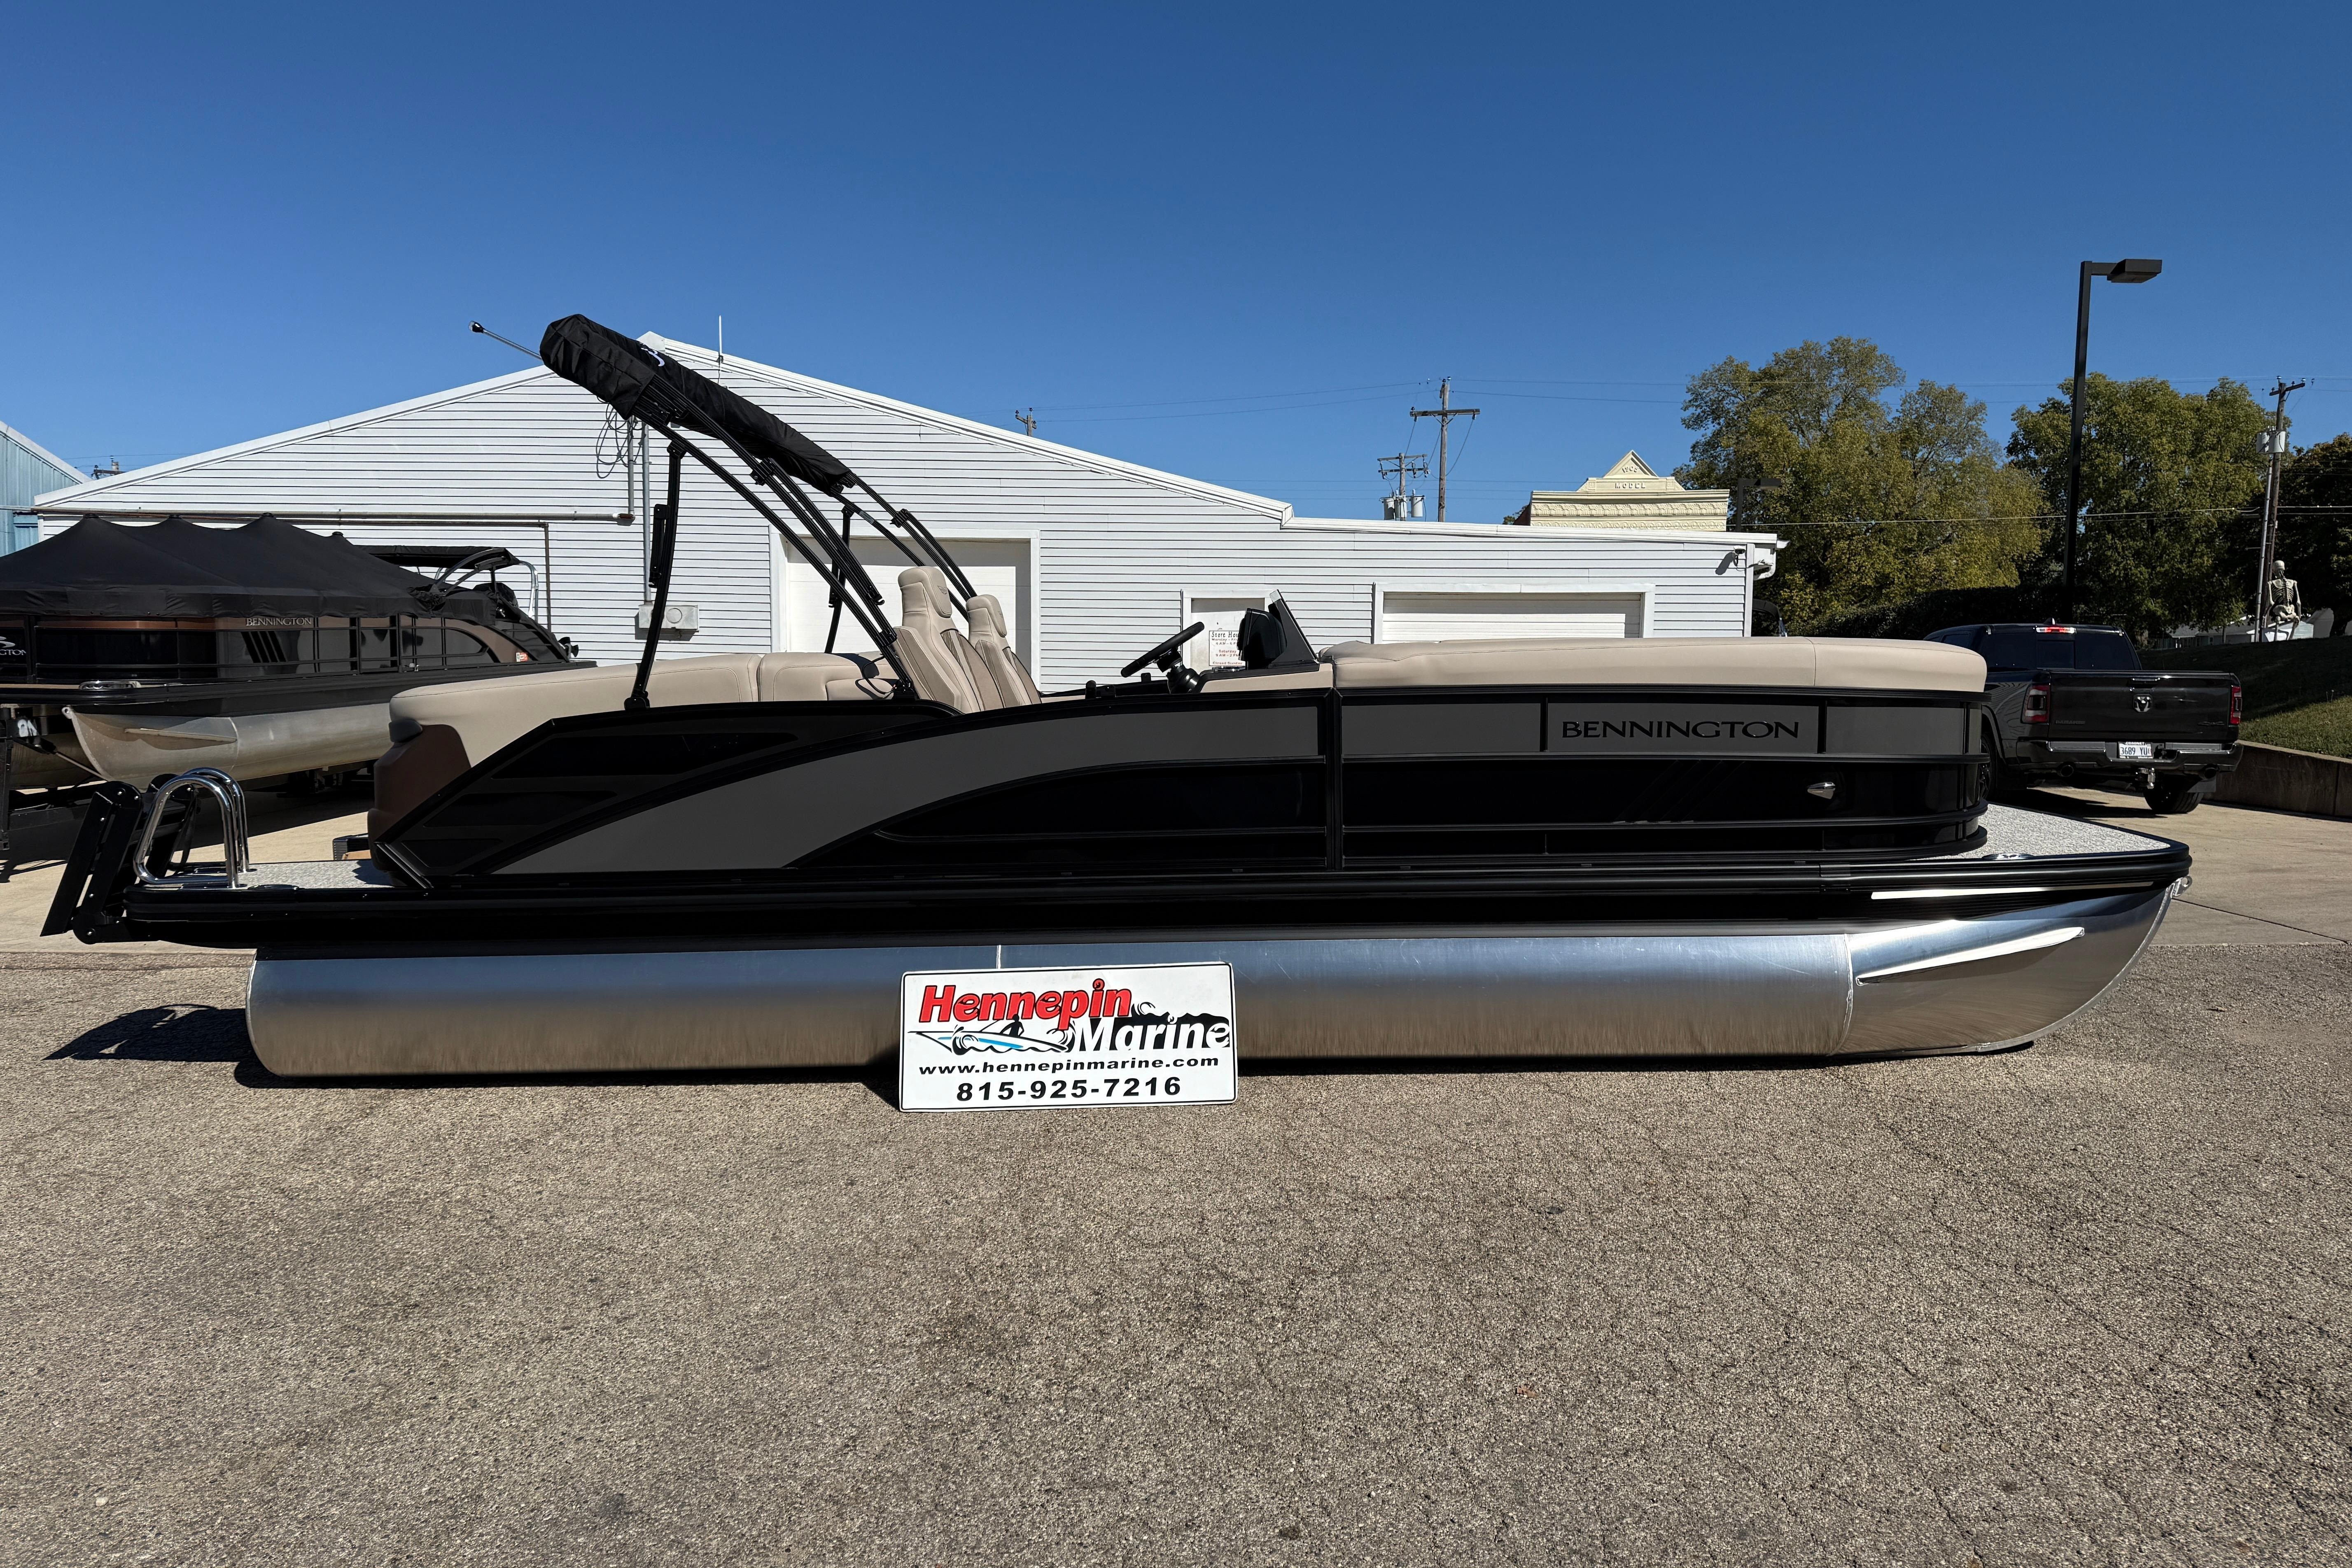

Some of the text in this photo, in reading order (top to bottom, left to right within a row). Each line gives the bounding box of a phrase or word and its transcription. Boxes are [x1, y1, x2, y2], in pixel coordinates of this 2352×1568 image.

[246, 618, 311, 626] BENNINGTON
[1562, 721, 1799, 738] BENNINGTON
[2120, 747, 2135, 755] 3689
[919, 978, 1132, 1031] Hennepin
[1072, 1014, 1231, 1051] Marine
[919, 1057, 1219, 1075] www.hennepinmarine.com
[956, 1076, 1181, 1101] 815-925-7216
